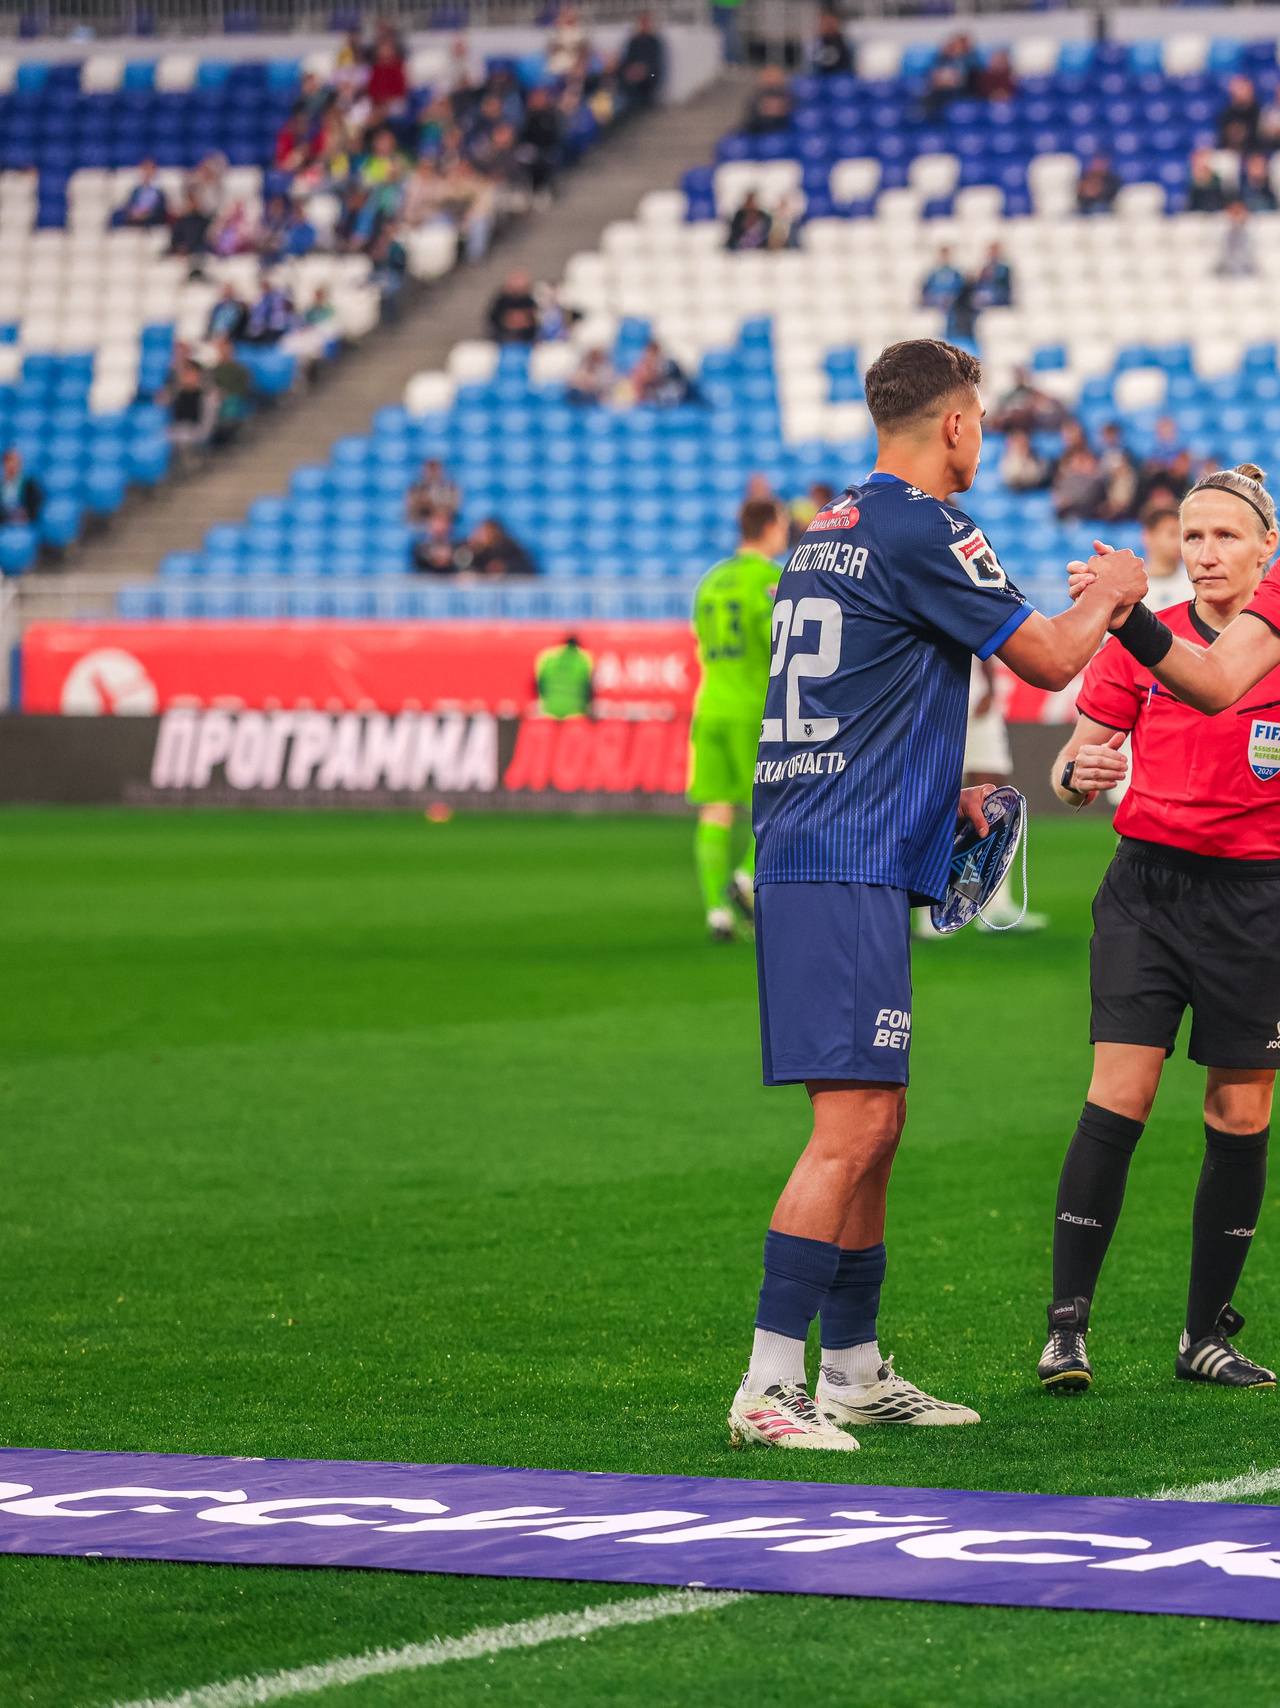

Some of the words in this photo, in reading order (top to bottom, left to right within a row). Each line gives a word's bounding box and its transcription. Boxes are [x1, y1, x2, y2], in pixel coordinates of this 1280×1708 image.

[786, 541, 869, 580] КОСТАНЗА
[758, 597, 843, 743] 22
[150, 712, 498, 791] ПРОГРАММА
[1257, 767, 1274, 776] 2026
[874, 1008, 911, 1031] FON
[872, 1028, 910, 1050] BET
